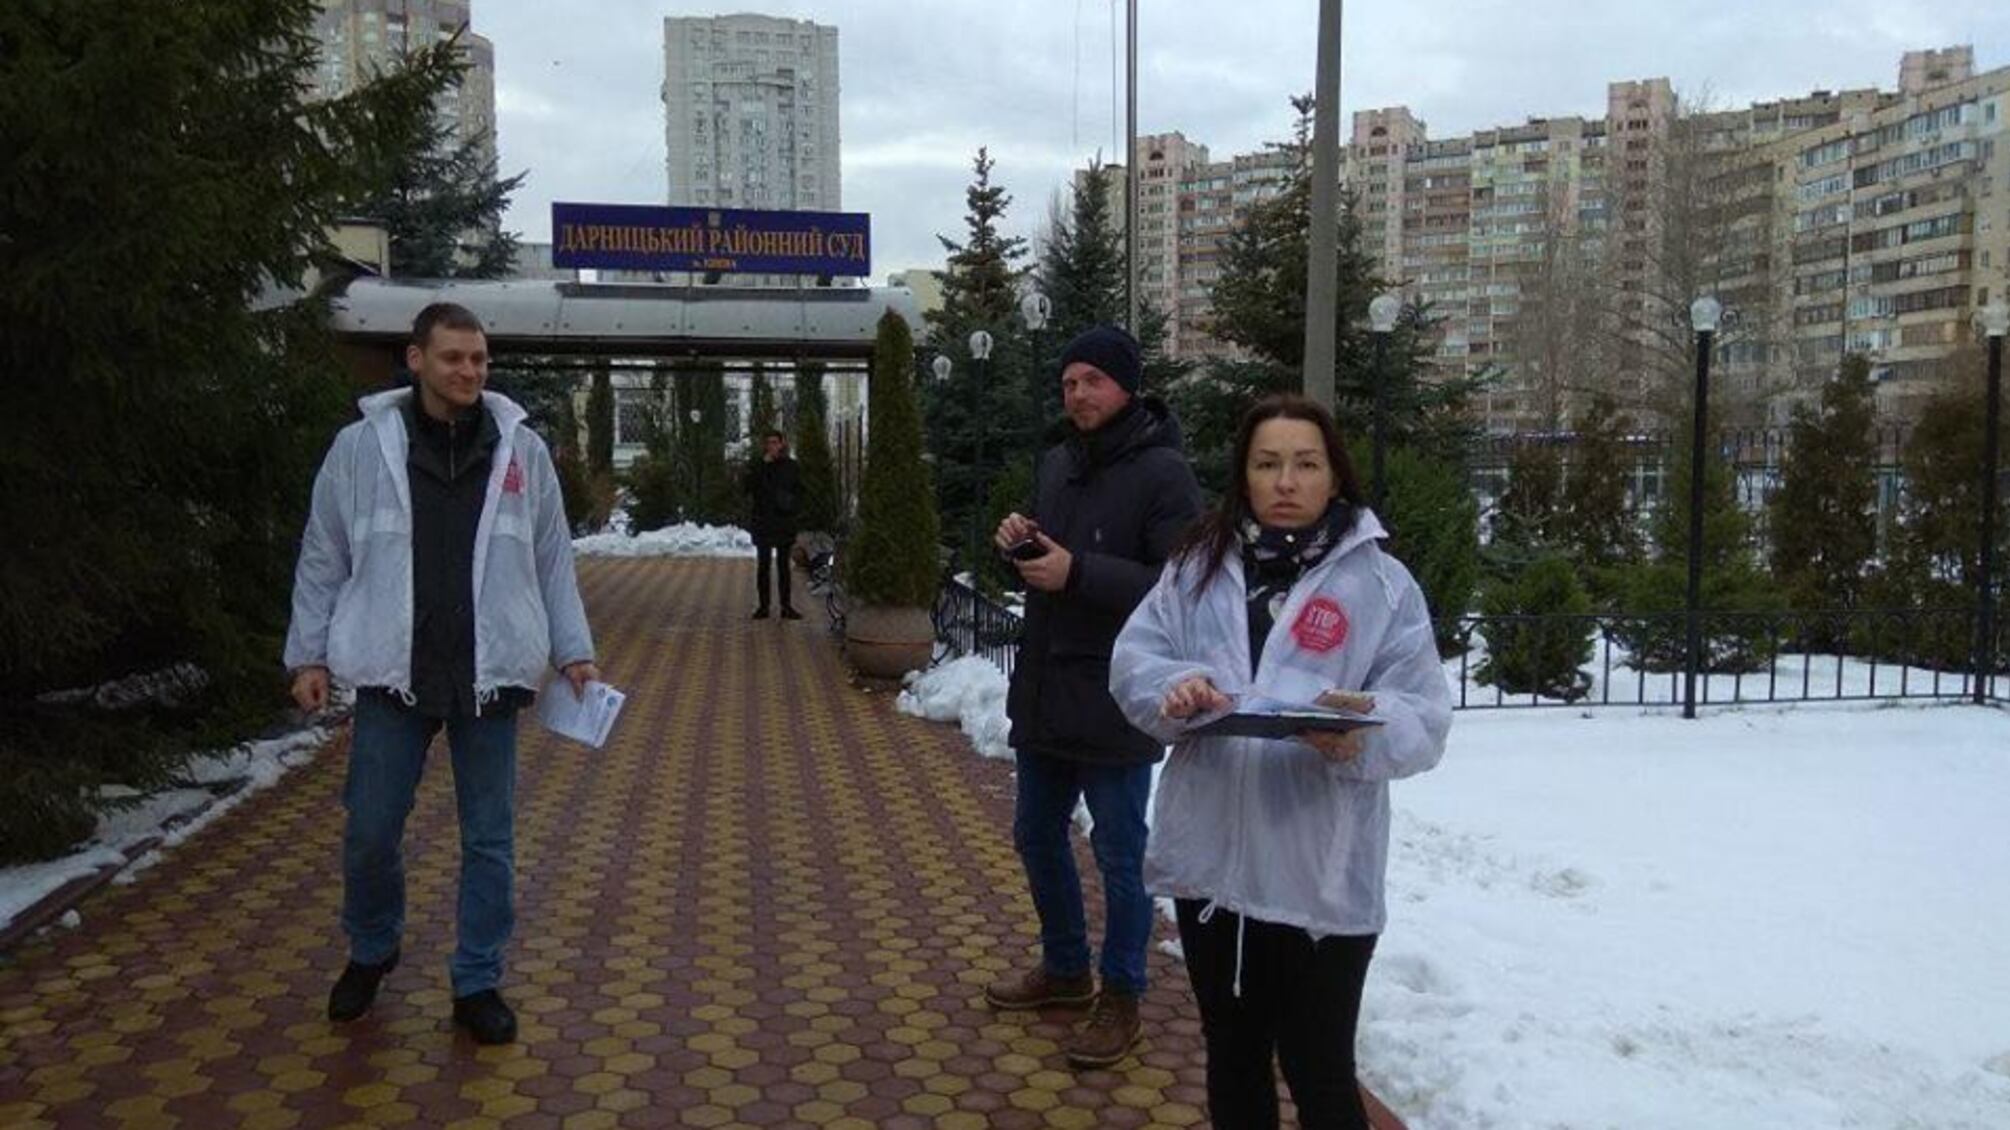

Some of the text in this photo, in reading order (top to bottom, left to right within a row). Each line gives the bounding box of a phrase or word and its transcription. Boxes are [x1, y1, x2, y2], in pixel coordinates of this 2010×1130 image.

[559, 223, 864, 261] ДАРНИЦЬКИЙ РАЙОННИЙ СУД
[1306, 606, 1340, 628] STOP
